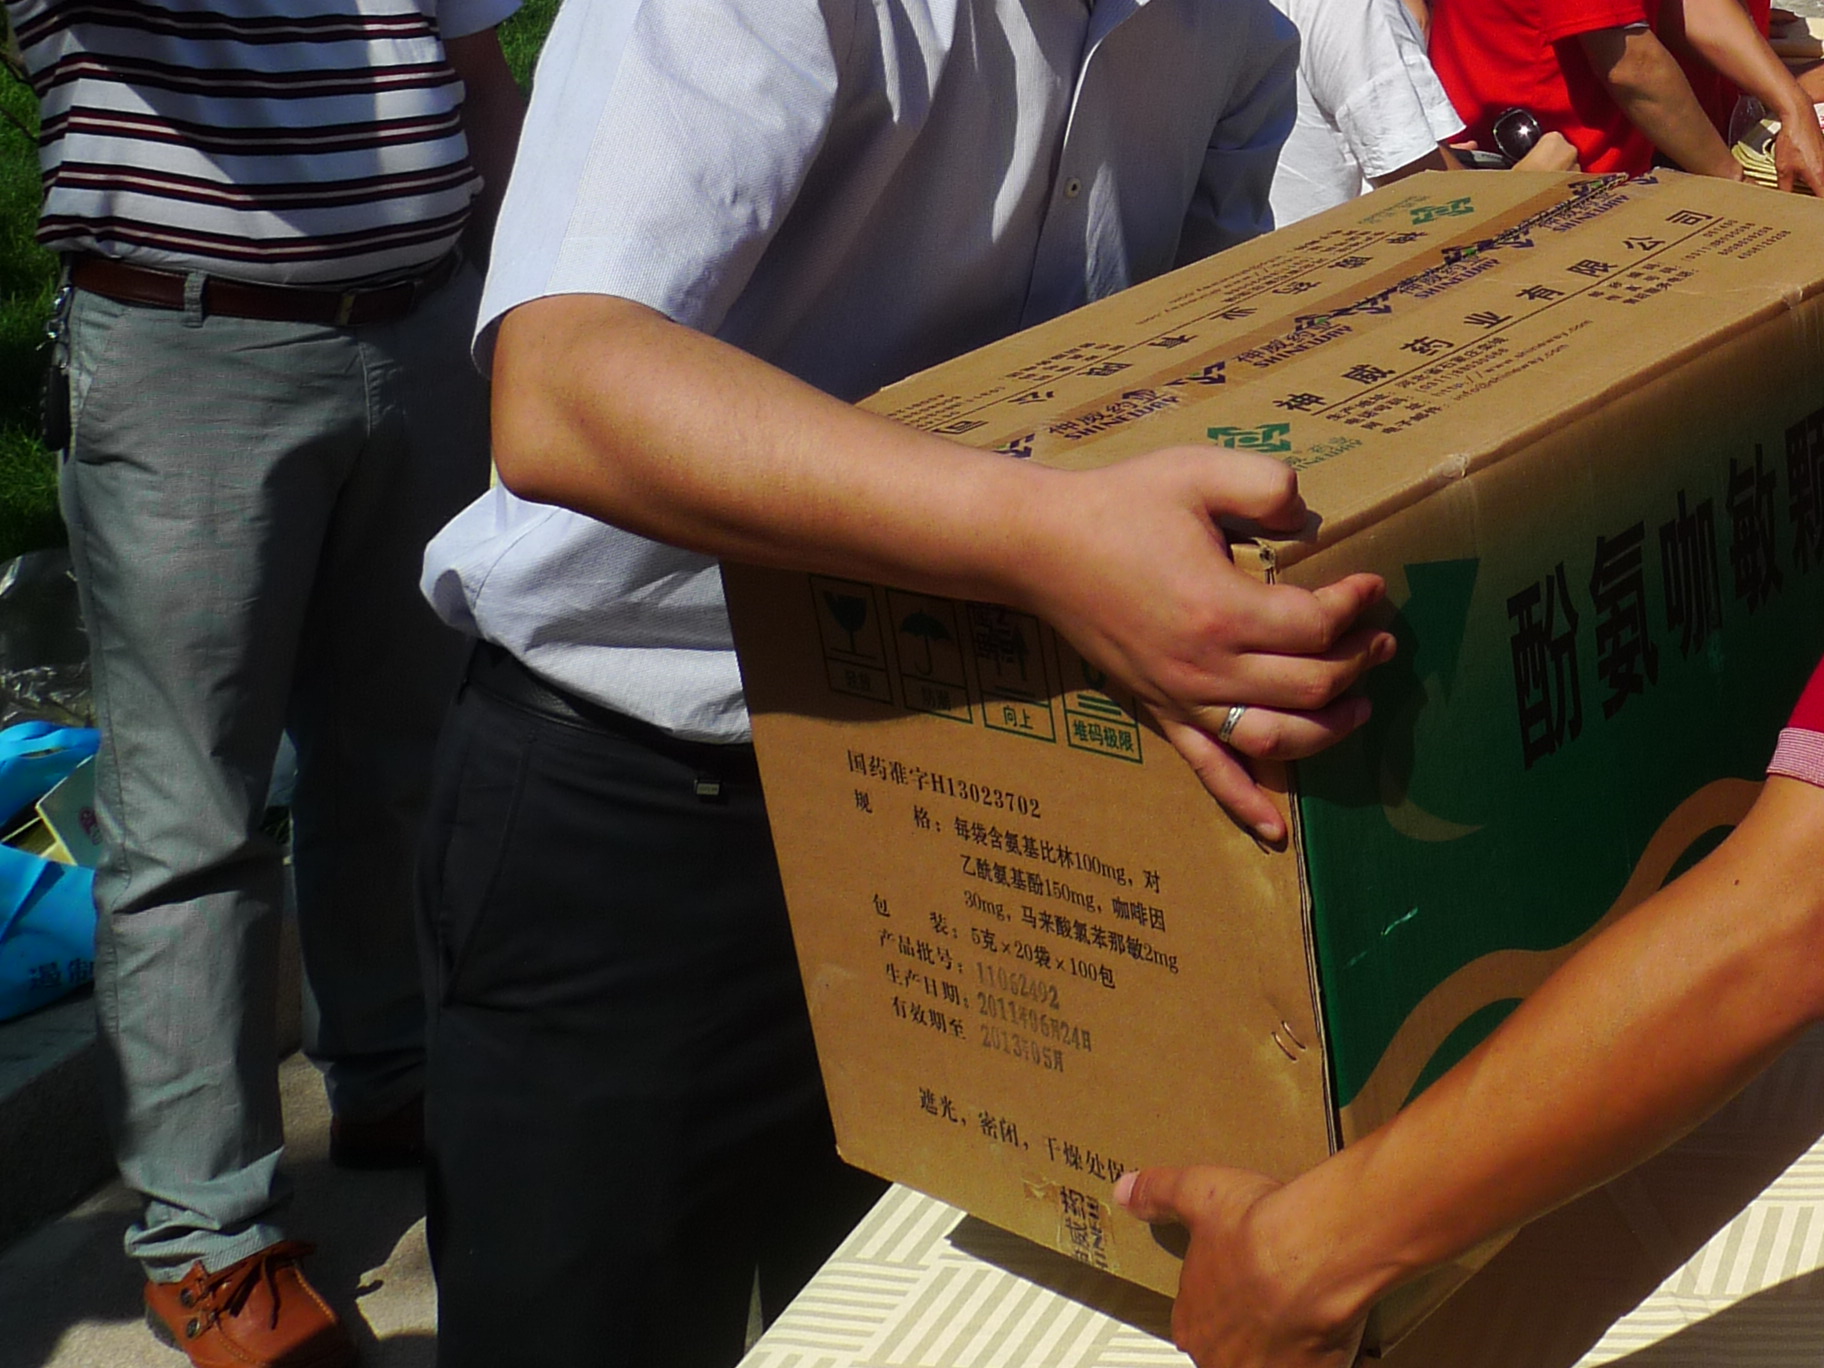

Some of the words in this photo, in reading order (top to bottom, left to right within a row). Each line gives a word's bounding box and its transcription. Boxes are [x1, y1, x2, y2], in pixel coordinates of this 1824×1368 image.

[1552, 194, 1631, 233] SHINEWAY
[1413, 258, 1501, 300] SHINEWAY
[1275, 209, 1714, 413] 神威药业有限公司
[1252, 323, 1354, 371] SHINEWAY
[1062, 394, 1182, 441] SHINEWAY
[1003, 704, 1034, 730] 向上
[1073, 719, 1135, 754] 堆码极限
[847, 749, 1042, 819] 国药准字H13023702
